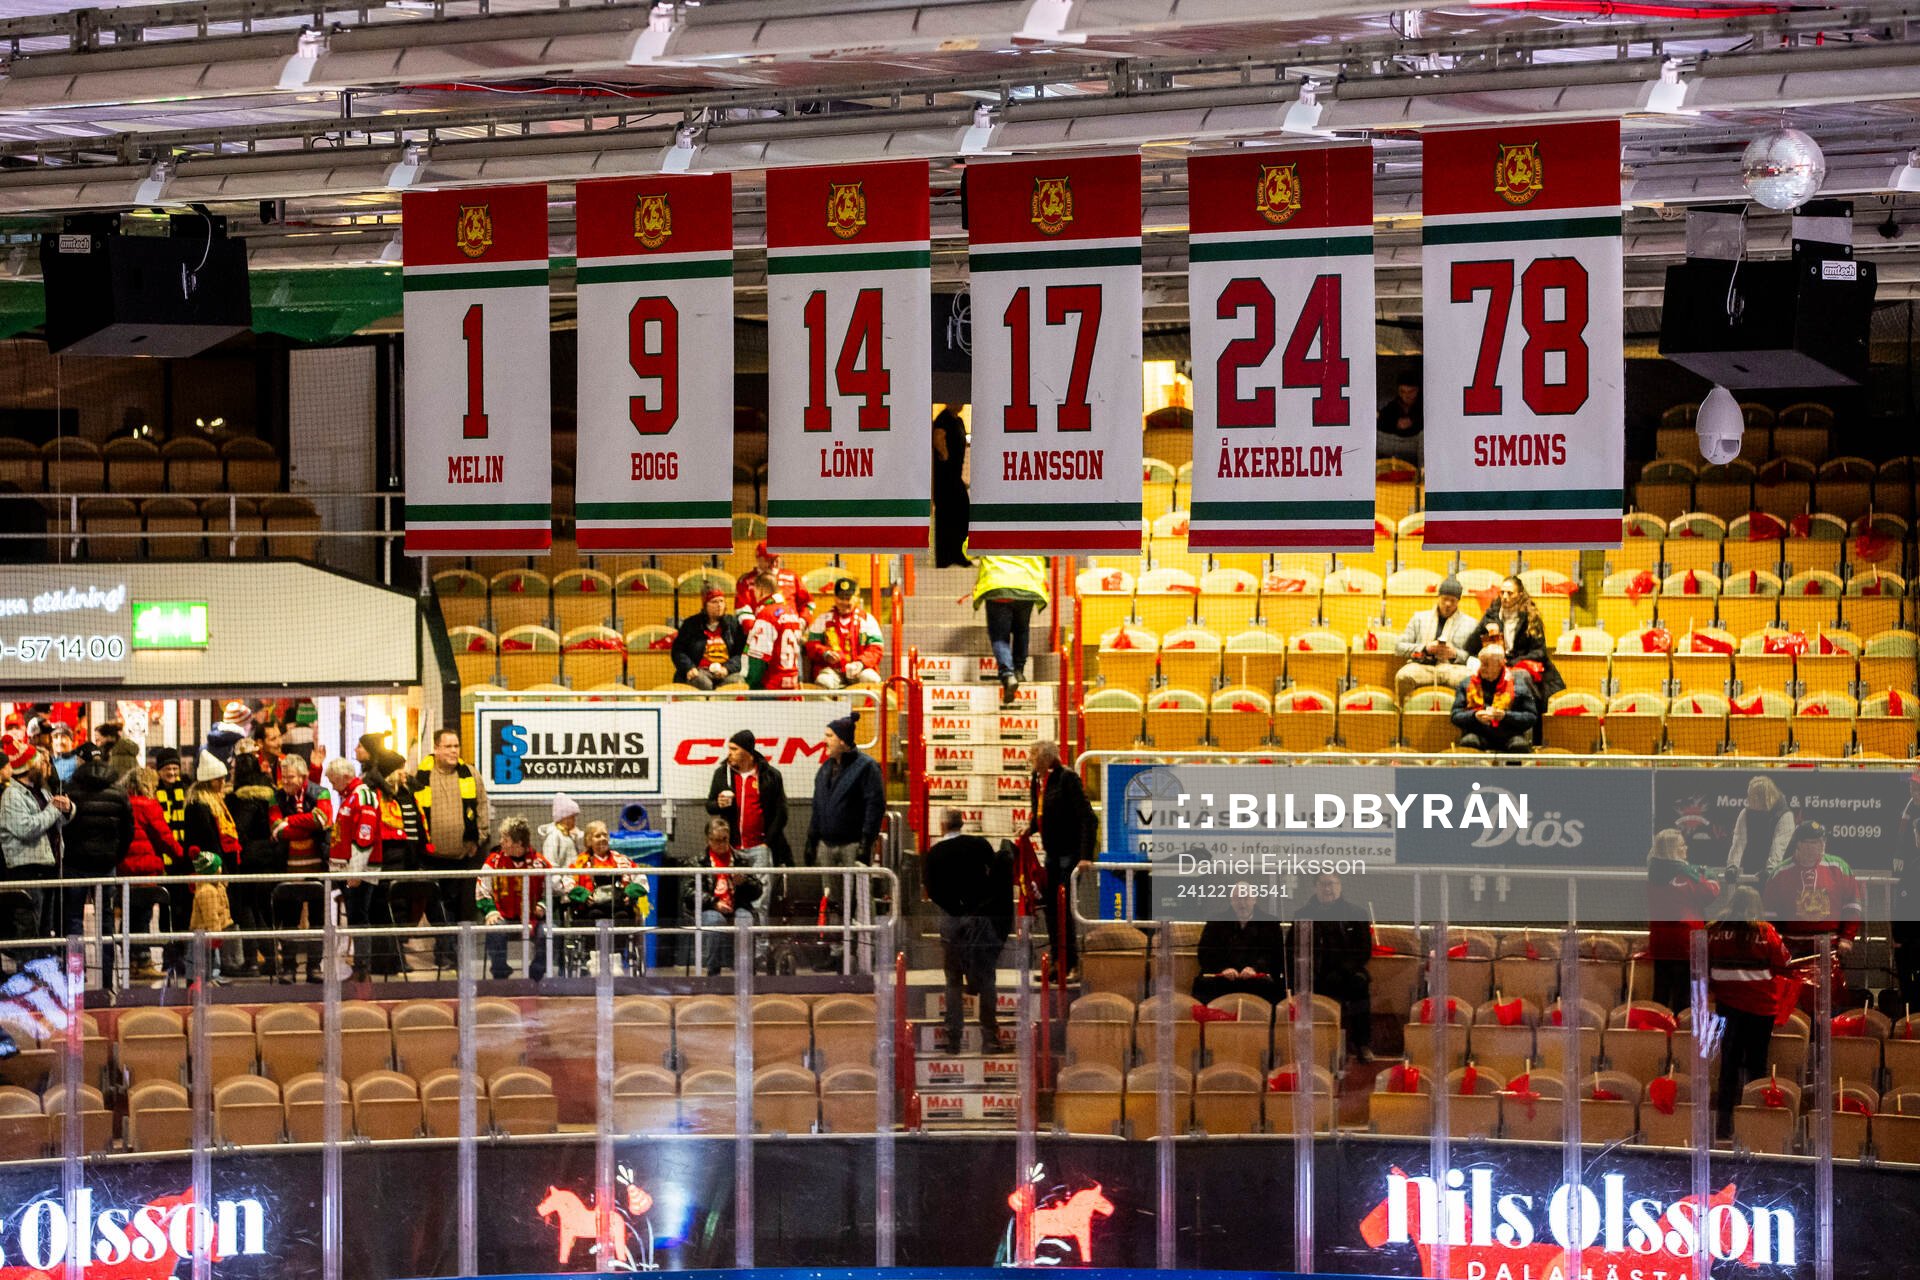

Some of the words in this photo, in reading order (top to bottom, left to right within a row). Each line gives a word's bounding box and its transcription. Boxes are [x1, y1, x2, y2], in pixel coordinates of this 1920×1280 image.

[1823, 264, 1856, 277] amtech
[1450, 256, 1589, 416] 78
[629, 296, 679, 434] 9
[803, 287, 891, 432] 14
[1003, 284, 1103, 431] 17
[1216, 276, 1350, 427] 24
[461, 304, 489, 438] 1
[820, 441, 874, 478] LÖNN
[1217, 438, 1343, 478] ÅKERBLOM
[1474, 433, 1567, 467] SIMONS
[447, 455, 504, 484] MELIN
[631, 451, 679, 481] BOGG
[1003, 450, 1104, 481] HANSSON
[0, 637, 51, 659] -57
[931, 688, 970, 700] MAXI
[1000, 688, 1037, 700] AXI
[932, 717, 970, 729] MAXI
[1000, 717, 1038, 729] MAXI
[501, 725, 644, 757] SILJANS
[934, 747, 973, 760] MAXI
[1002, 747, 1030, 760] MA
[494, 754, 614, 785] BYGGTJÄNST
[621, 762, 641, 774] AB
[929, 777, 968, 789] MAXI
[998, 777, 1031, 789] MAX
[1464, 786, 1585, 848] Diös
[1804, 795, 1882, 811] Fönsterputs
[928, 1062, 964, 1074] MAXI
[927, 1096, 964, 1108] MAXI
[20, 1187, 266, 1271] Olsson
[1548, 1173, 1797, 1267] Olsson
